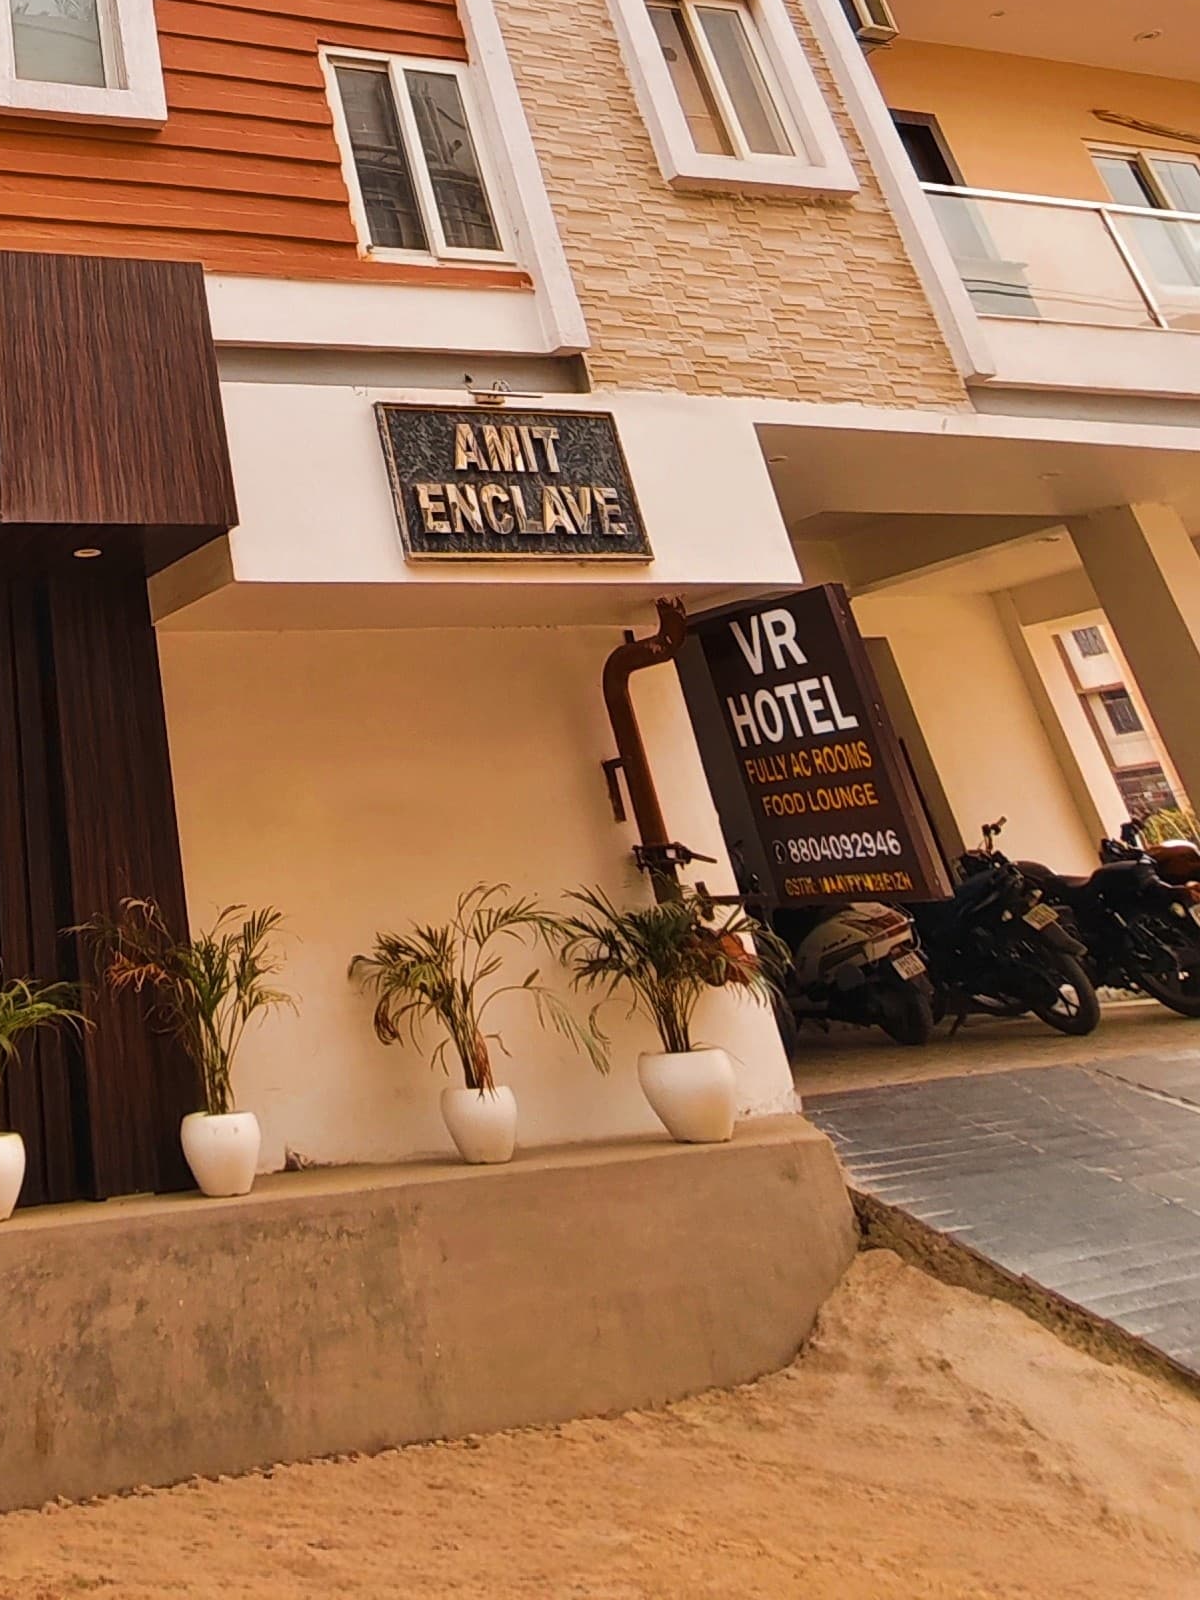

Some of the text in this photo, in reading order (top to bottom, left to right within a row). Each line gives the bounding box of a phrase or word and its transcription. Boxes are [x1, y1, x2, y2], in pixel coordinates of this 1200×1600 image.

[454, 422, 561, 473] AMIT
[413, 482, 630, 536] ENCLAVE
[728, 607, 808, 675] VR
[726, 675, 860, 748] HOTEL
[744, 740, 873, 785] FULLY AC ROOMS
[762, 782, 879, 817] FOOD LOUNGE
[787, 829, 902, 864] 8804092946
